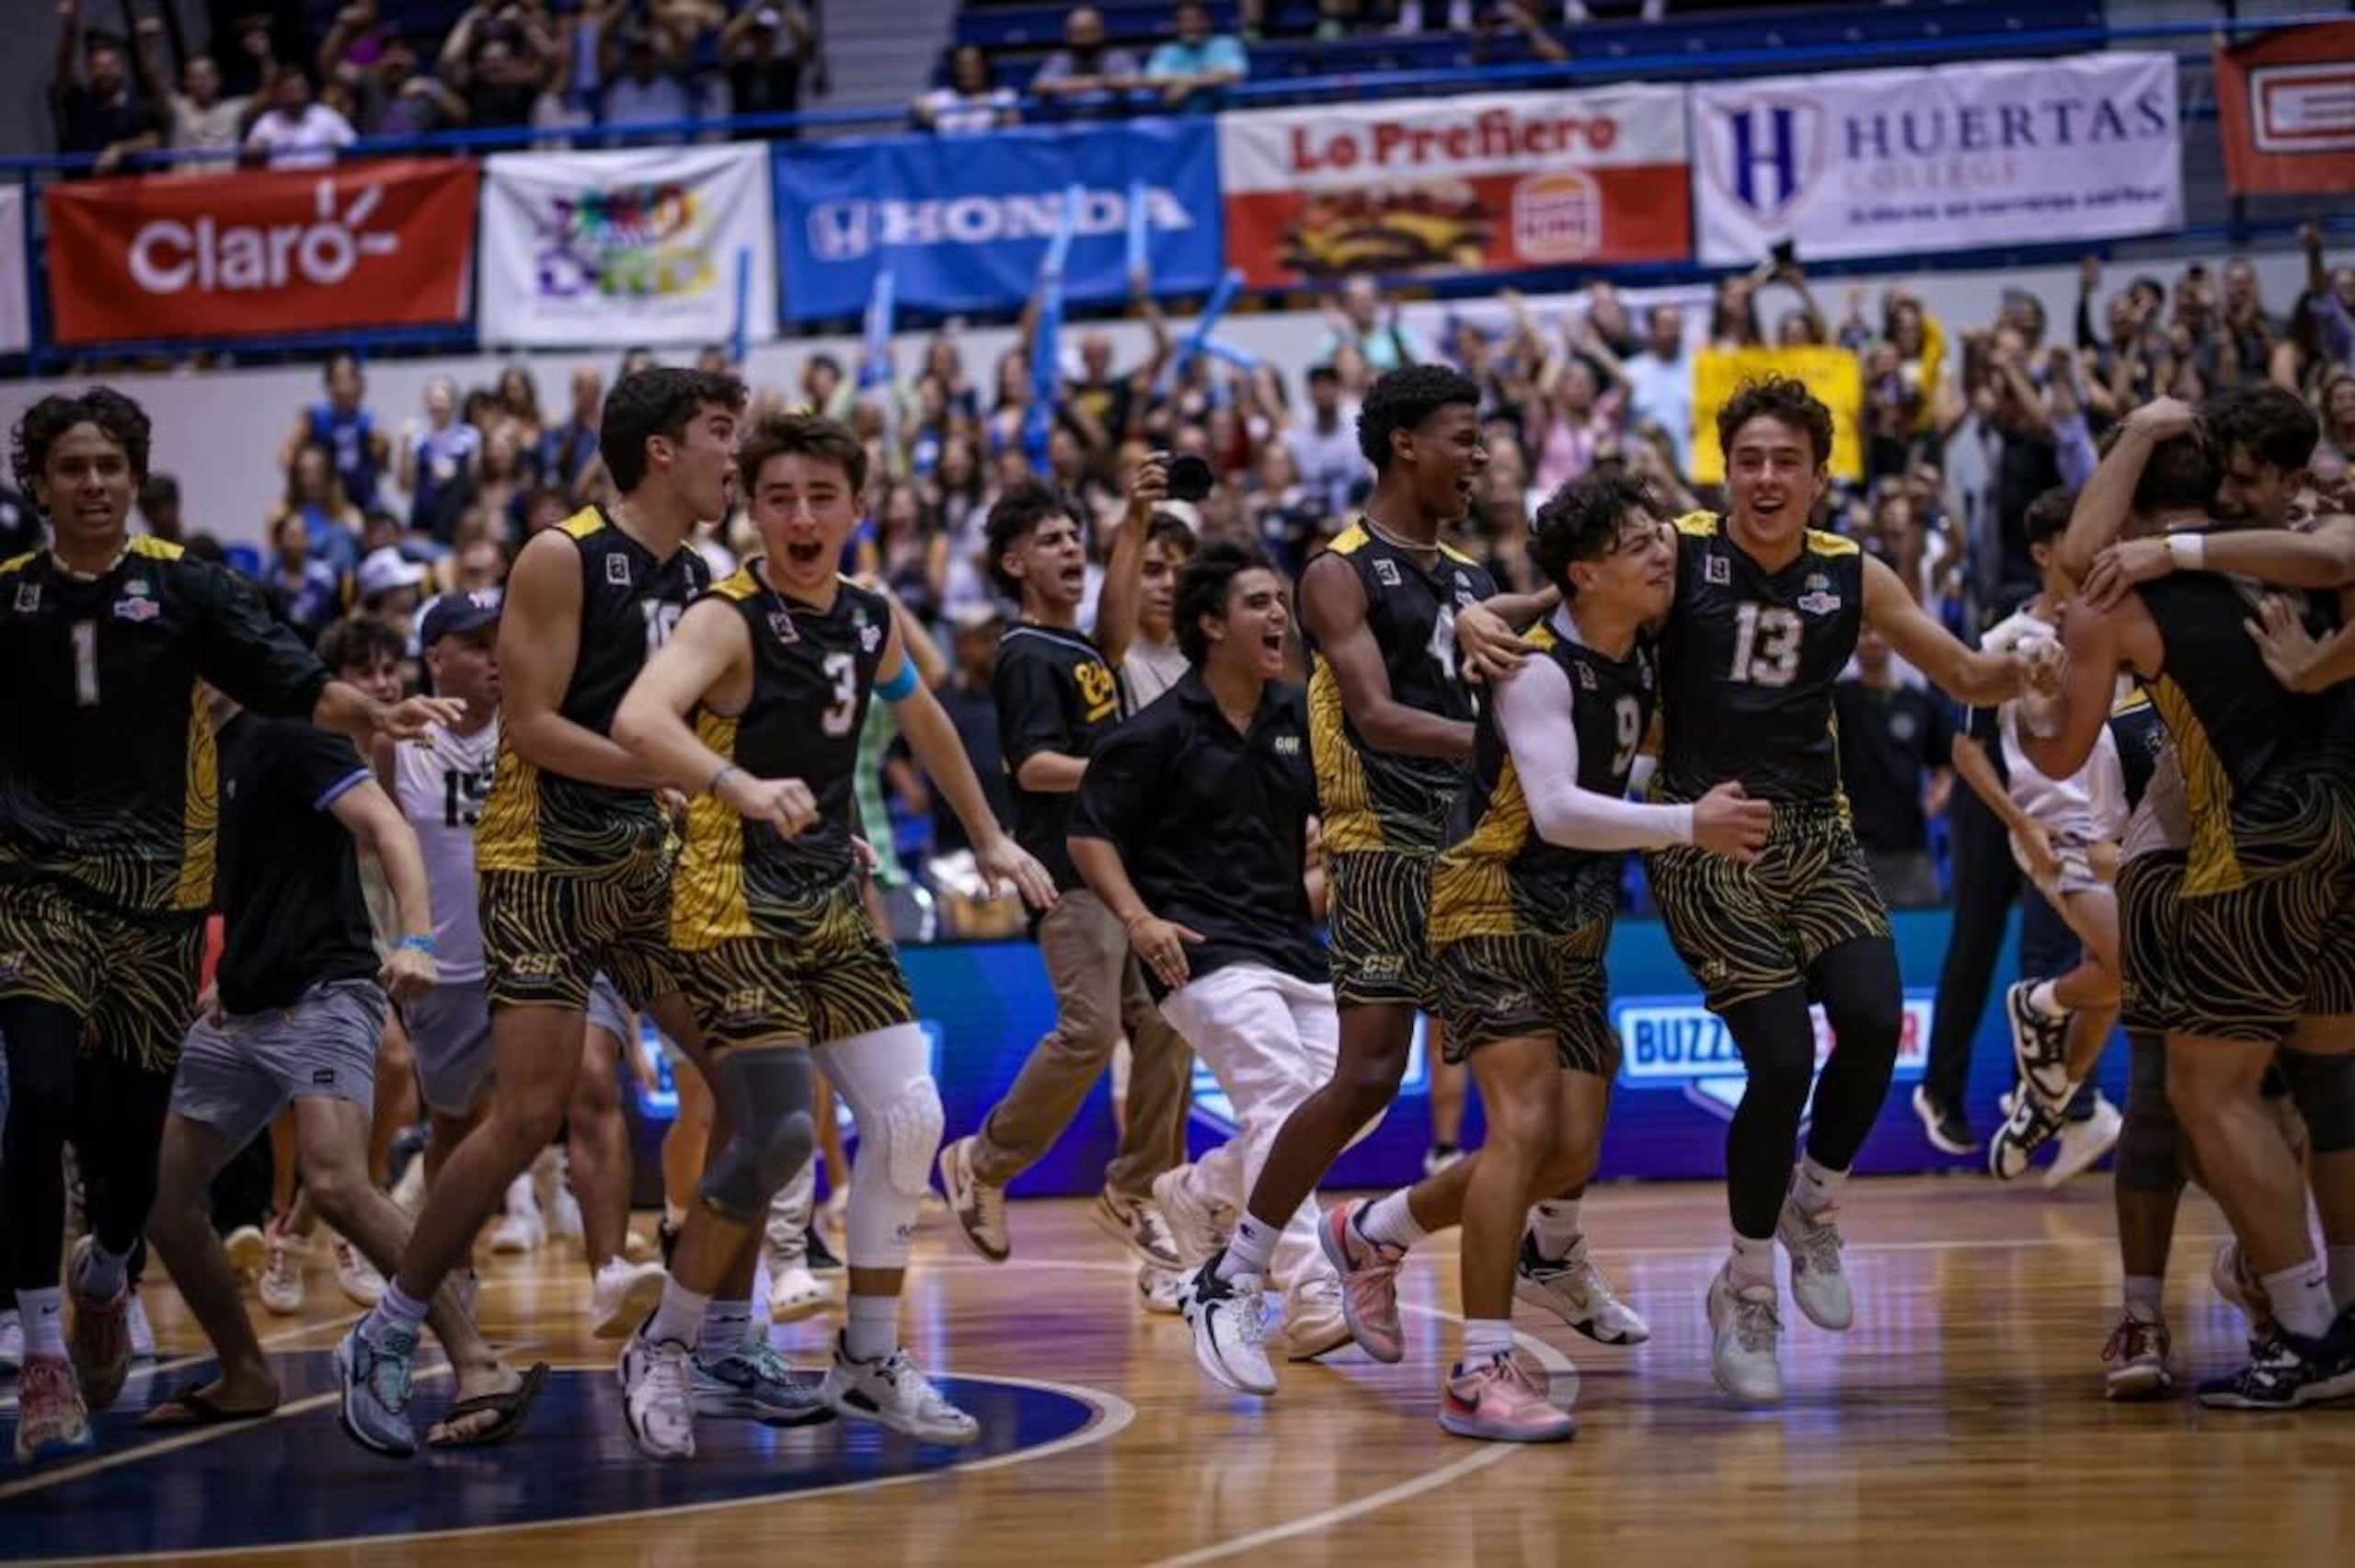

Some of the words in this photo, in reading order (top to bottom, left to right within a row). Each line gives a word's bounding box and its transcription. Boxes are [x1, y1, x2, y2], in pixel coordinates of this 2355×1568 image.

[1292, 126, 1356, 171] Lo
[1371, 109, 1616, 166] Prefiero
[1844, 93, 2166, 160] HUERTAS
[129, 214, 357, 294] Claro
[880, 189, 1193, 246] HONDA
[71, 619, 99, 705] 1
[1729, 601, 1804, 687] 13
[822, 651, 856, 735] 3
[1613, 694, 1640, 776] 9
[1362, 954, 1405, 973] CSI
[1637, 1017, 1741, 1066] BUZZ
